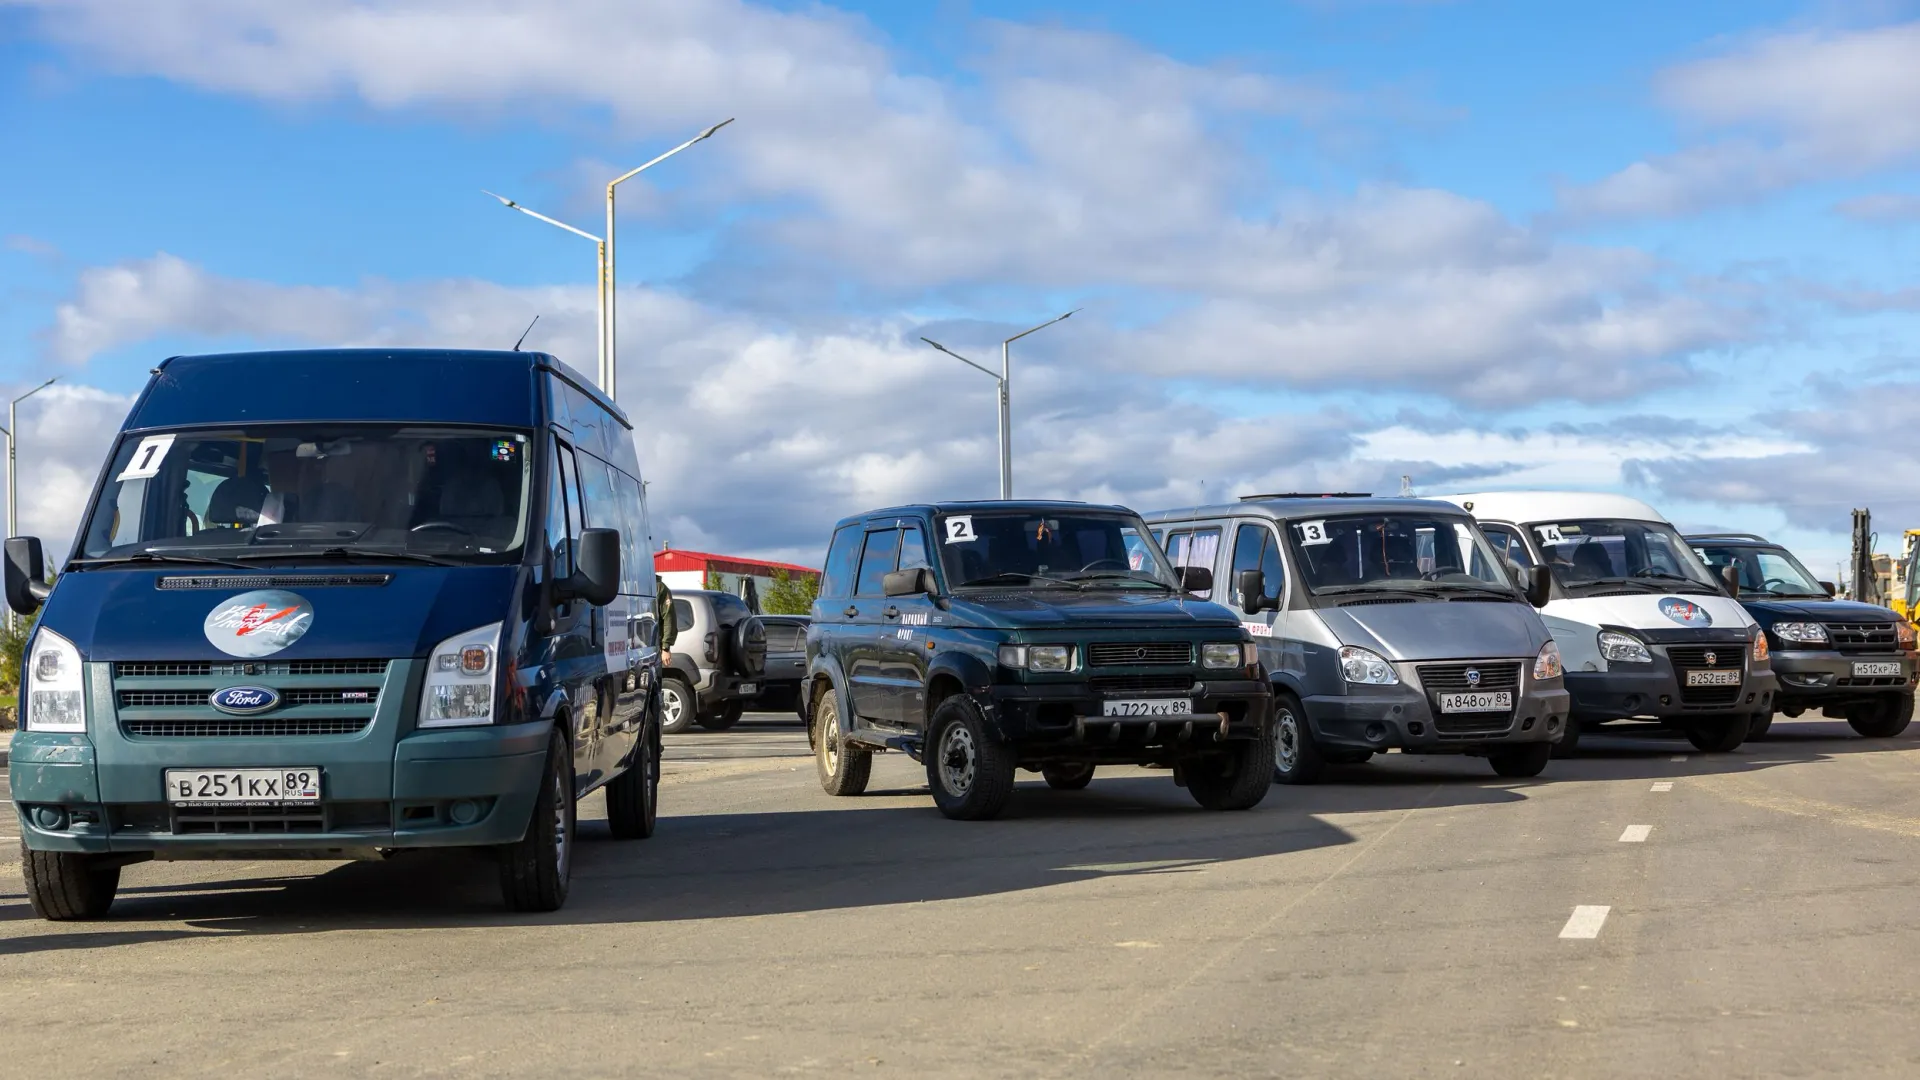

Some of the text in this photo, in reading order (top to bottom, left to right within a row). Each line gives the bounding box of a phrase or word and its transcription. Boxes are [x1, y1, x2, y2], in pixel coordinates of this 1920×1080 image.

[139, 445, 158, 470] 1
[952, 521, 968, 538] 2
[1307, 525, 1321, 540] 3
[1547, 529, 1559, 541] 4
[1691, 672, 1738, 684] В252ЕЕ 89
[225, 690, 261, 706] Ford
[1446, 693, 1508, 708] А848ОУ 89
[1111, 701, 1187, 716] А722КХ 89
[179, 772, 310, 798] В251КХ 89
[284, 789, 303, 797] RUS
